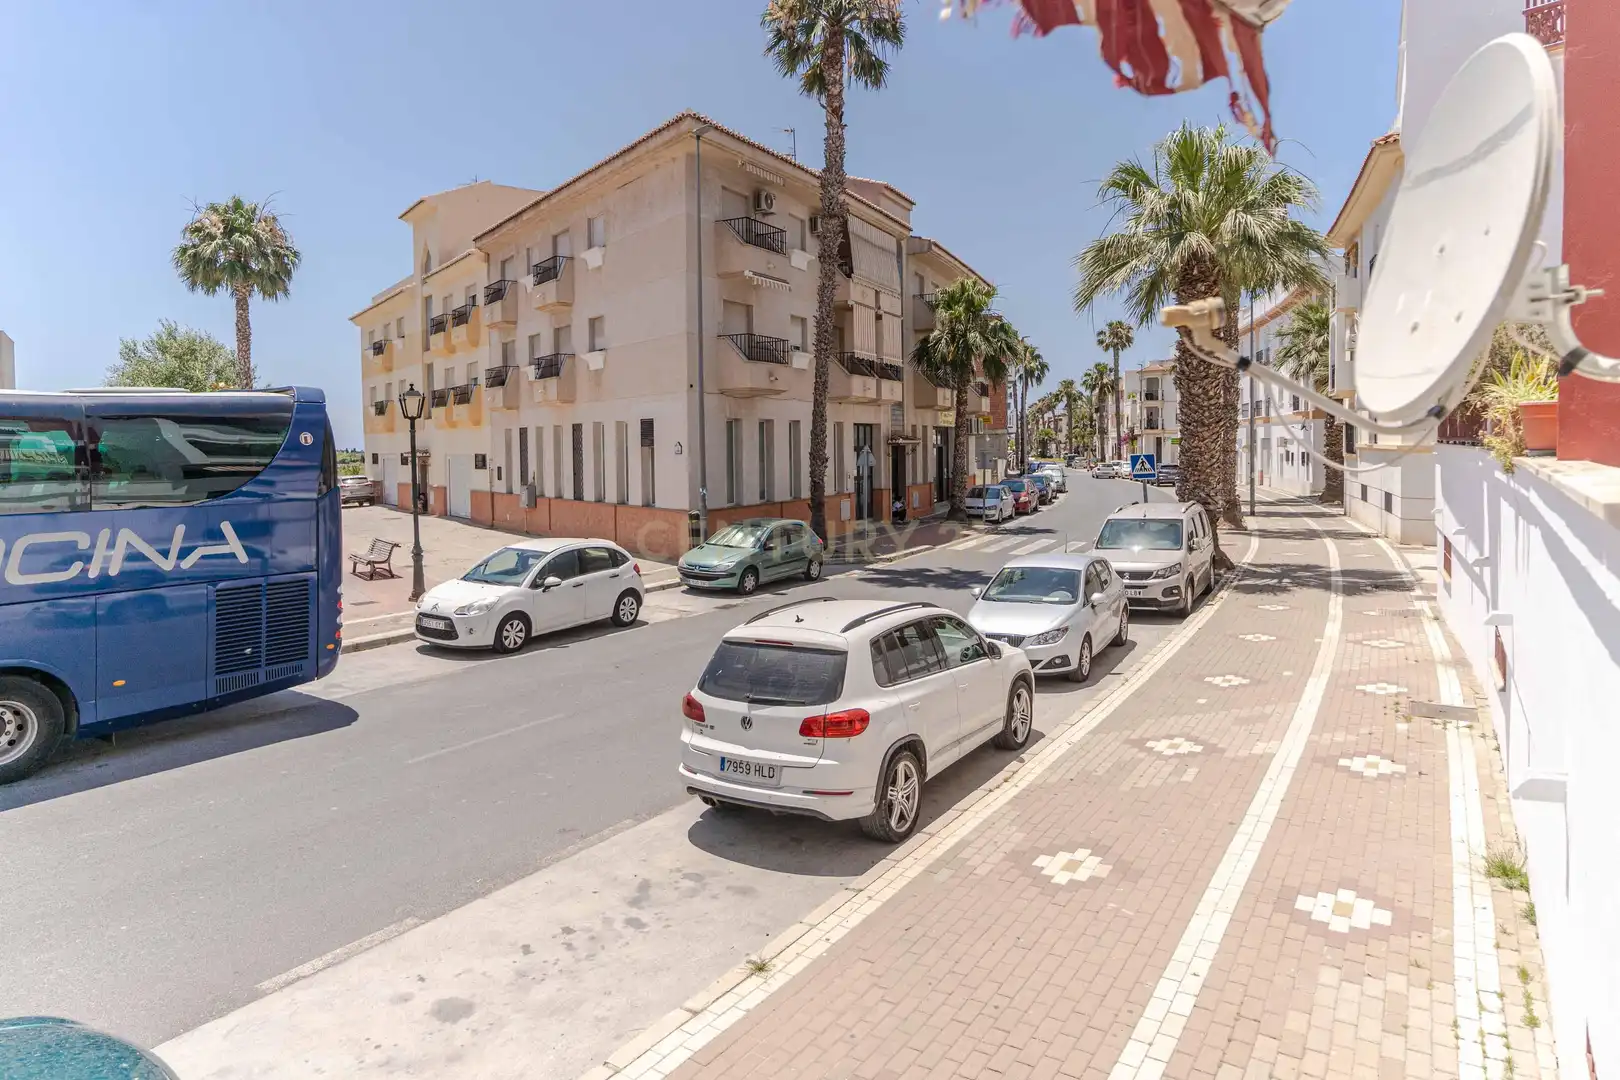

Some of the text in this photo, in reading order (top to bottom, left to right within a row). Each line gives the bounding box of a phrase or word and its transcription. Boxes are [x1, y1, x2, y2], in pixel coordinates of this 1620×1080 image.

[0, 520, 249, 585] CINA
[726, 760, 775, 779] 7959 HLD
